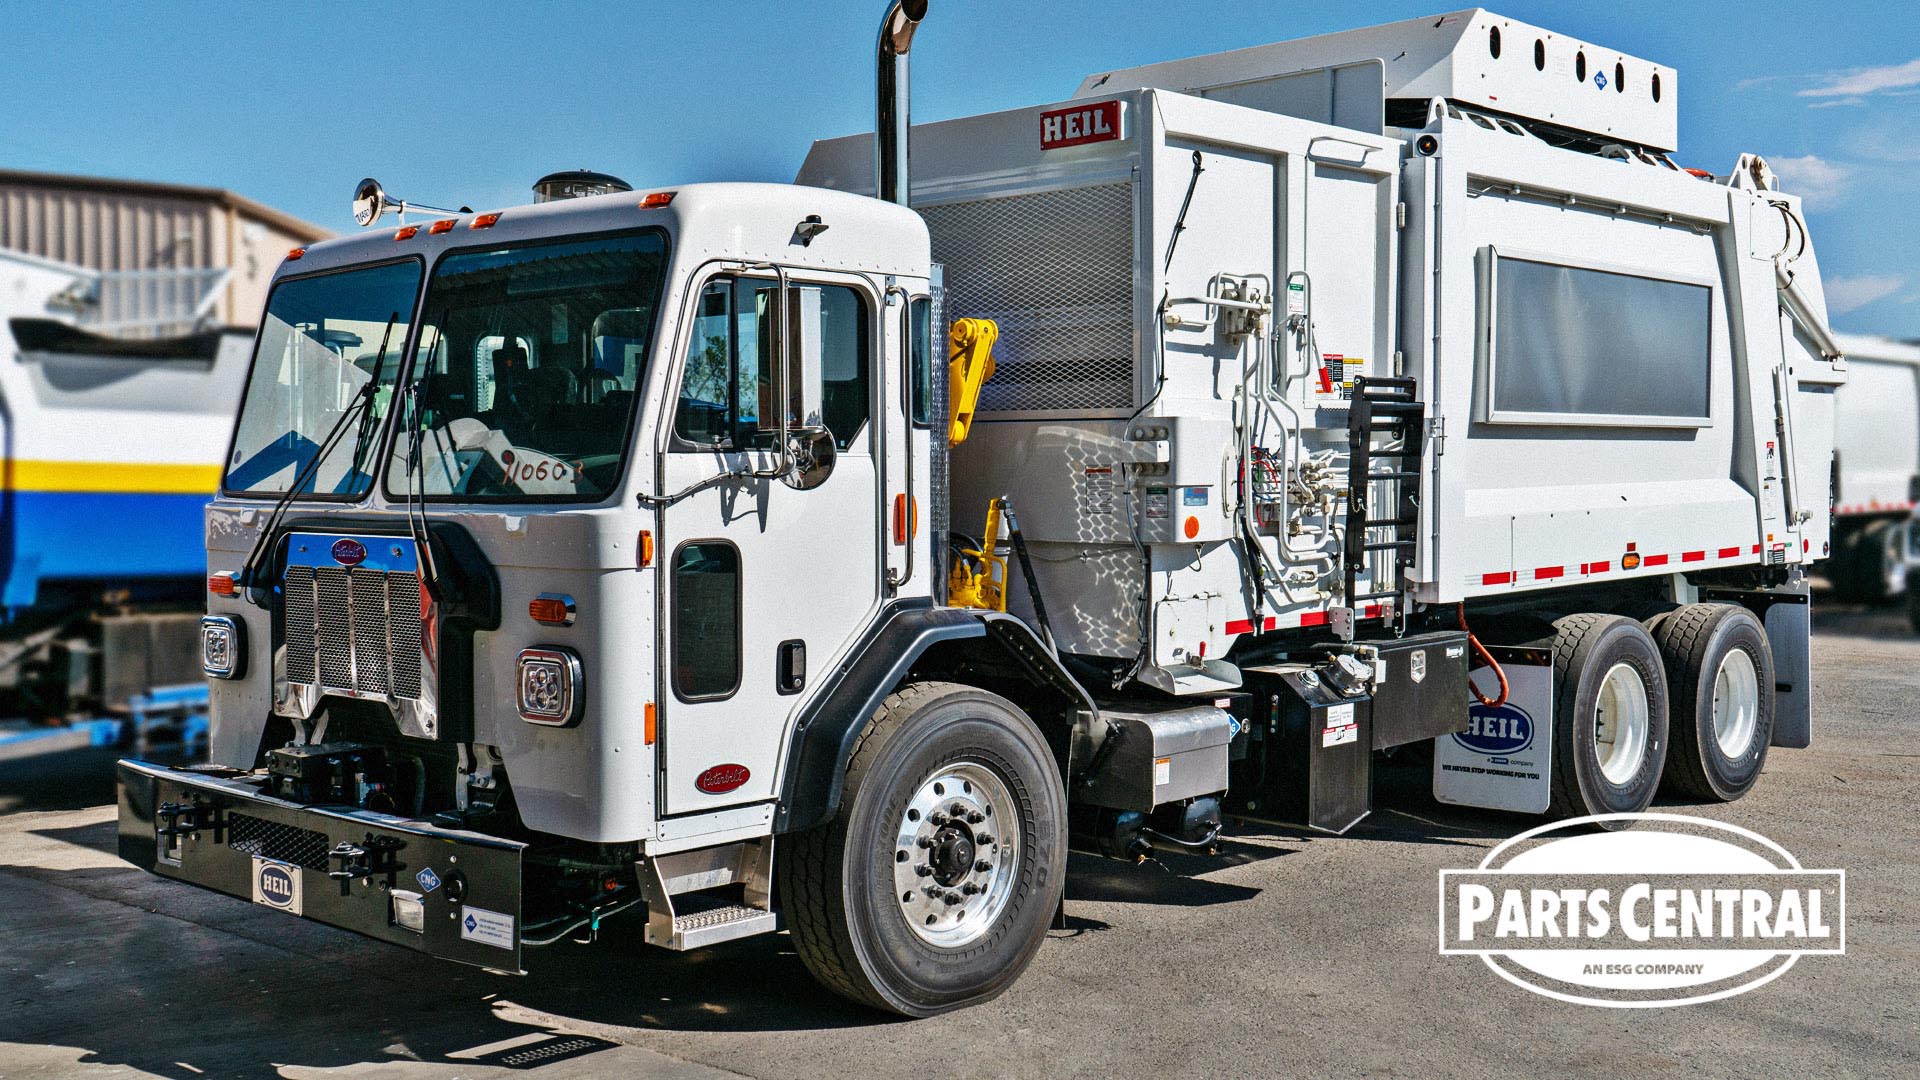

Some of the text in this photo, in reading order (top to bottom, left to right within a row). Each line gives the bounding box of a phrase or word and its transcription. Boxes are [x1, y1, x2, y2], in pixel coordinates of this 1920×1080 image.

[1043, 109, 1111, 143] HEIL
[1463, 716, 1524, 740] HEIL
[703, 768, 746, 788] Peterbilt
[1452, 765, 1470, 773] NEVER
[1486, 768, 1514, 777] WORKING
[1514, 771, 1527, 779] FOR
[1527, 772, 1540, 780] YOU
[263, 873, 291, 897] HEIL
[420, 873, 436, 887] CNG
